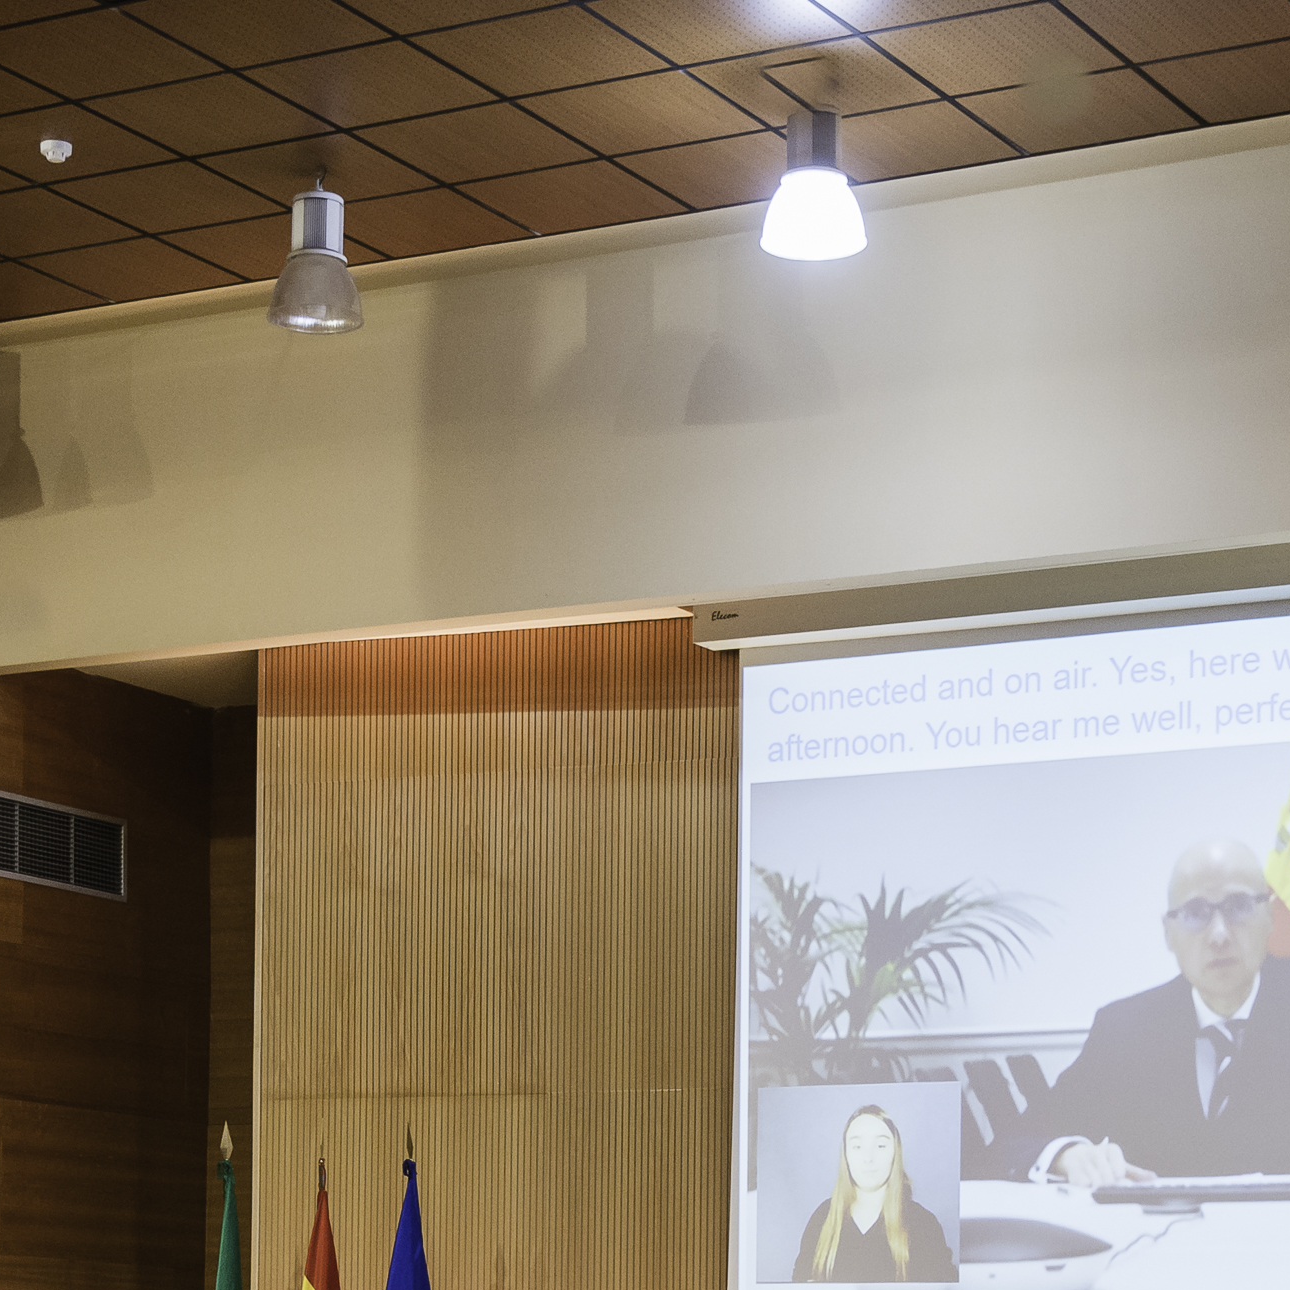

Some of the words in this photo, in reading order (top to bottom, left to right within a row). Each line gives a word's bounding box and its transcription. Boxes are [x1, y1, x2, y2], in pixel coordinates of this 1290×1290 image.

[768, 674, 926, 714] Connected
[937, 668, 992, 701] and
[1004, 671, 1040, 694] on
[1053, 661, 1098, 690] air.
[1109, 655, 1176, 685] Yes,
[1189, 649, 1260, 679] here
[767, 730, 914, 762] afternoon.
[925, 720, 981, 750] You
[993, 717, 1062, 744] hear
[1073, 713, 1119, 739] me
[1131, 699, 1202, 734] well,
